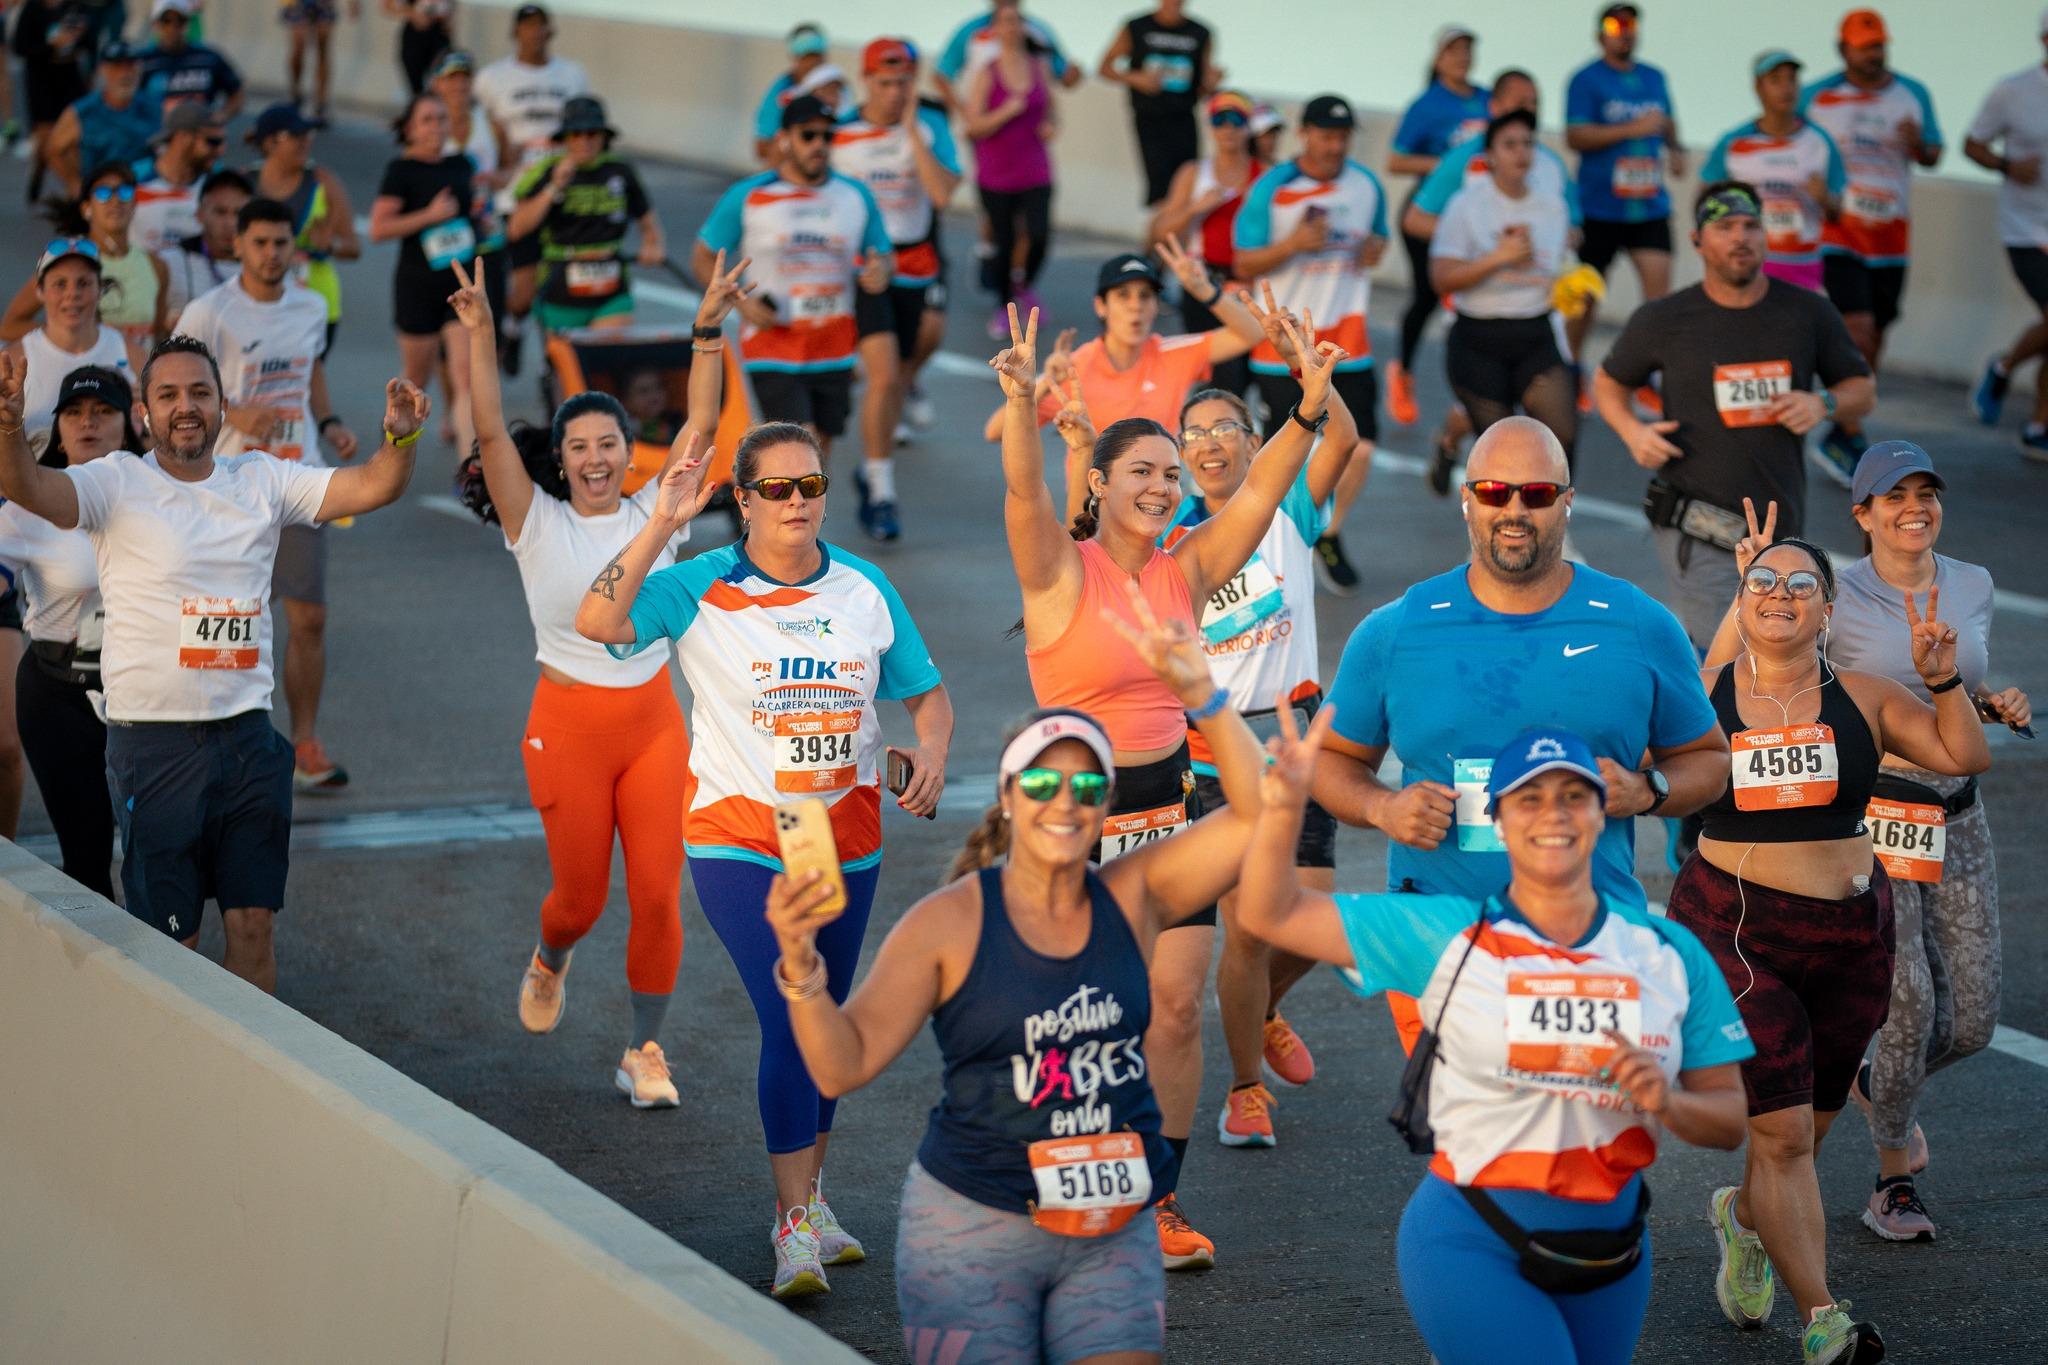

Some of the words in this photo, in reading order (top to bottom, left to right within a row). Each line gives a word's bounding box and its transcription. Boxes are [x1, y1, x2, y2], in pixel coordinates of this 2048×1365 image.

[196, 616, 252, 642] 4761
[776, 621, 816, 633] TURISMO
[1256, 619, 1292, 645] RICO
[751, 661, 773, 673] PR
[778, 657, 838, 680] 10K
[840, 661, 866, 673] RUN
[752, 699, 766, 710] LA
[767, 700, 812, 712] CARRERA
[813, 700, 832, 711] DEL
[833, 699, 867, 710] PUENTE
[790, 733, 852, 764] 3934
[1749, 744, 1823, 778] 4585
[1871, 819, 1934, 852] 1684
[1024, 984, 1124, 1056] positive
[1530, 996, 1619, 1034] 4933
[1050, 1089, 1112, 1137] only
[1057, 1161, 1133, 1200] 5168
